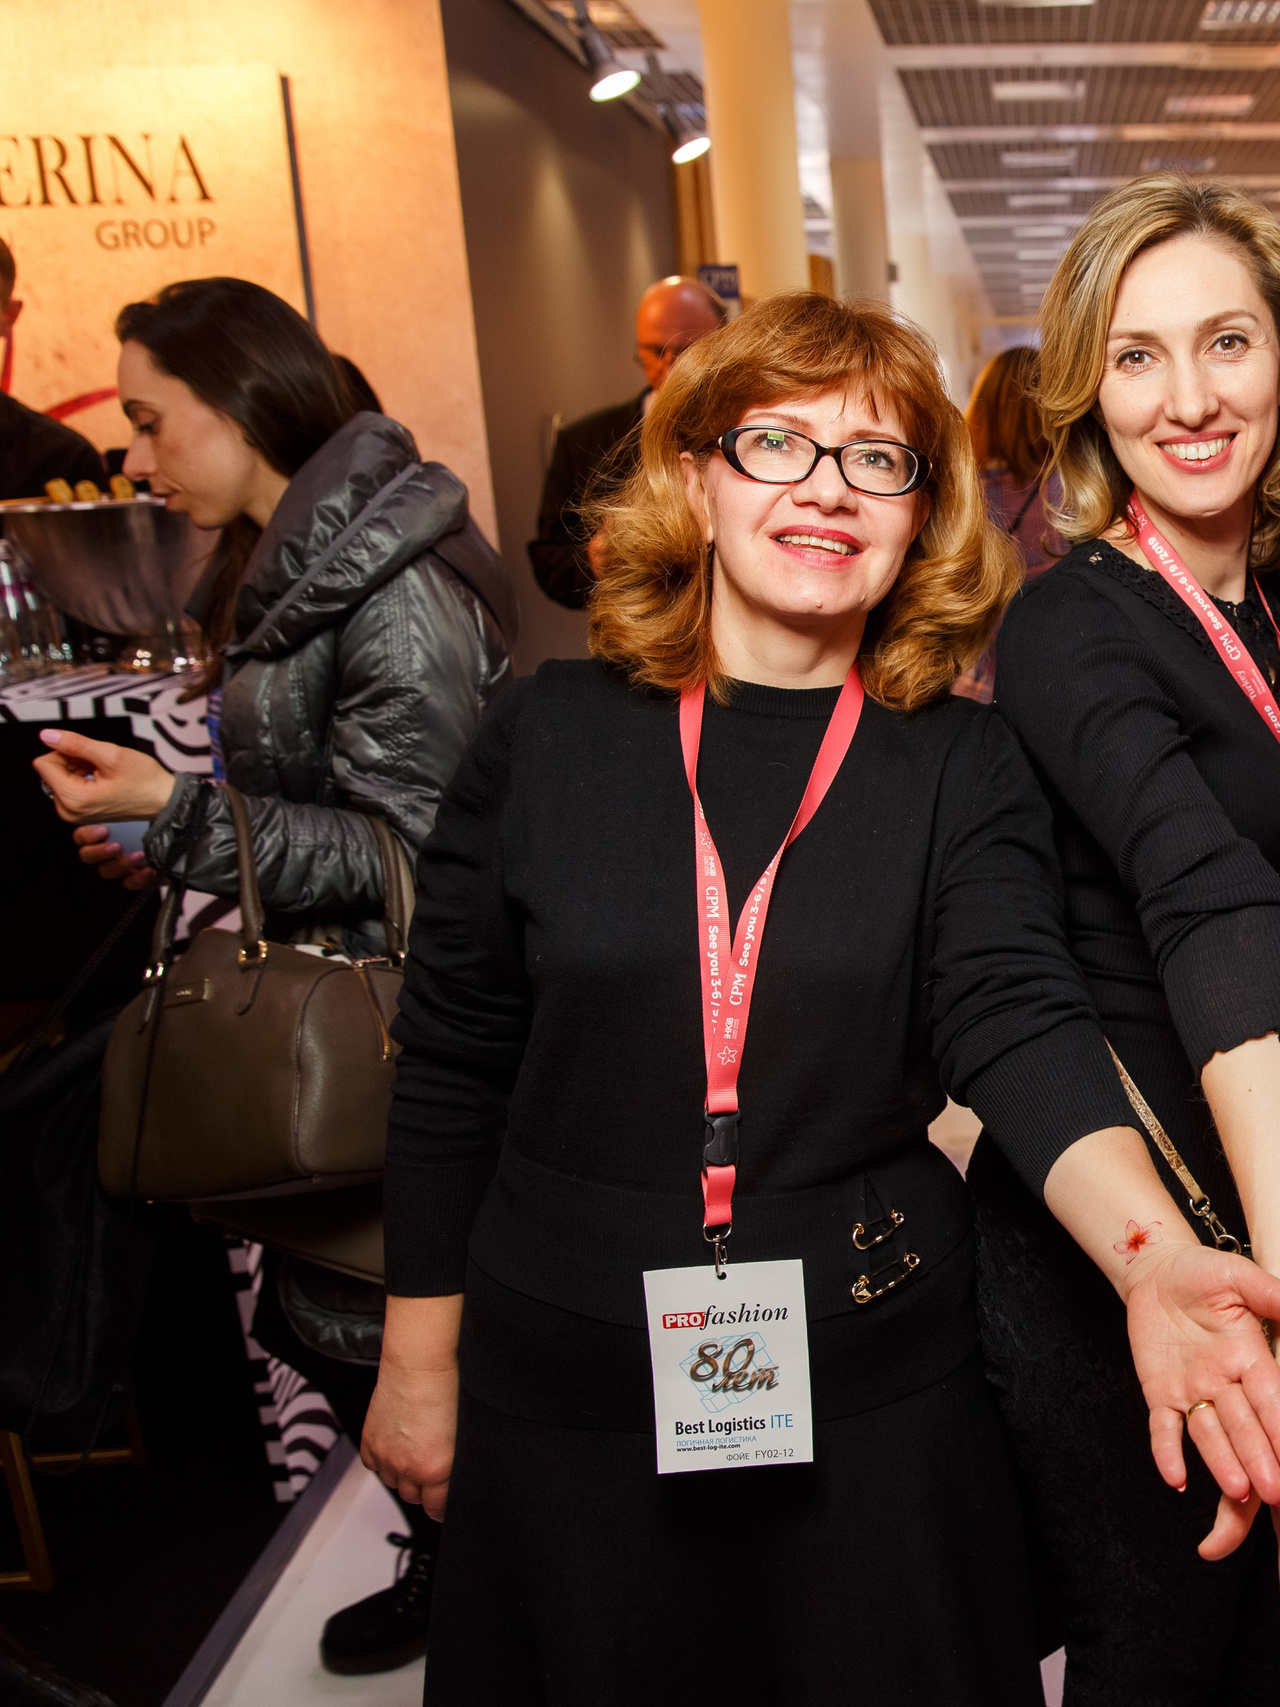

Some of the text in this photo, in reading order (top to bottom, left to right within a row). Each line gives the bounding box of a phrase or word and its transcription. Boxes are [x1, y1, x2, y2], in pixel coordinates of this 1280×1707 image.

[95, 217, 217, 251] GROUP
[1148, 536, 1168, 559] 2019
[1169, 564, 1178, 574] 9
[1178, 575, 1194, 594] 3-6
[1192, 591, 1211, 612] you
[1206, 609, 1223, 631] See
[1219, 633, 1241, 661] CPM
[1236, 670, 1257, 700] Turkey
[1264, 704, 1280, 731] 2019
[706, 886, 720, 918] CPM
[750, 893, 762, 914] 3-6
[708, 925, 719, 948] See
[744, 916, 757, 941] you
[707, 950, 719, 976] you
[739, 942, 751, 967] See
[711, 978, 722, 999] 3-6
[729, 973, 747, 1006] CPM
[690, 1337, 755, 1382] 80
[711, 1363, 779, 1393] лет
[675, 1413, 794, 1436] Best Logistics ITE
[676, 1435, 757, 1447] ЛОГИЧНАЯ ЛОГИСТИКА
[676, 1443, 741, 1453] www.best-log-ite.com
[726, 1448, 794, 1461] ФОЙЕ FY02-12
